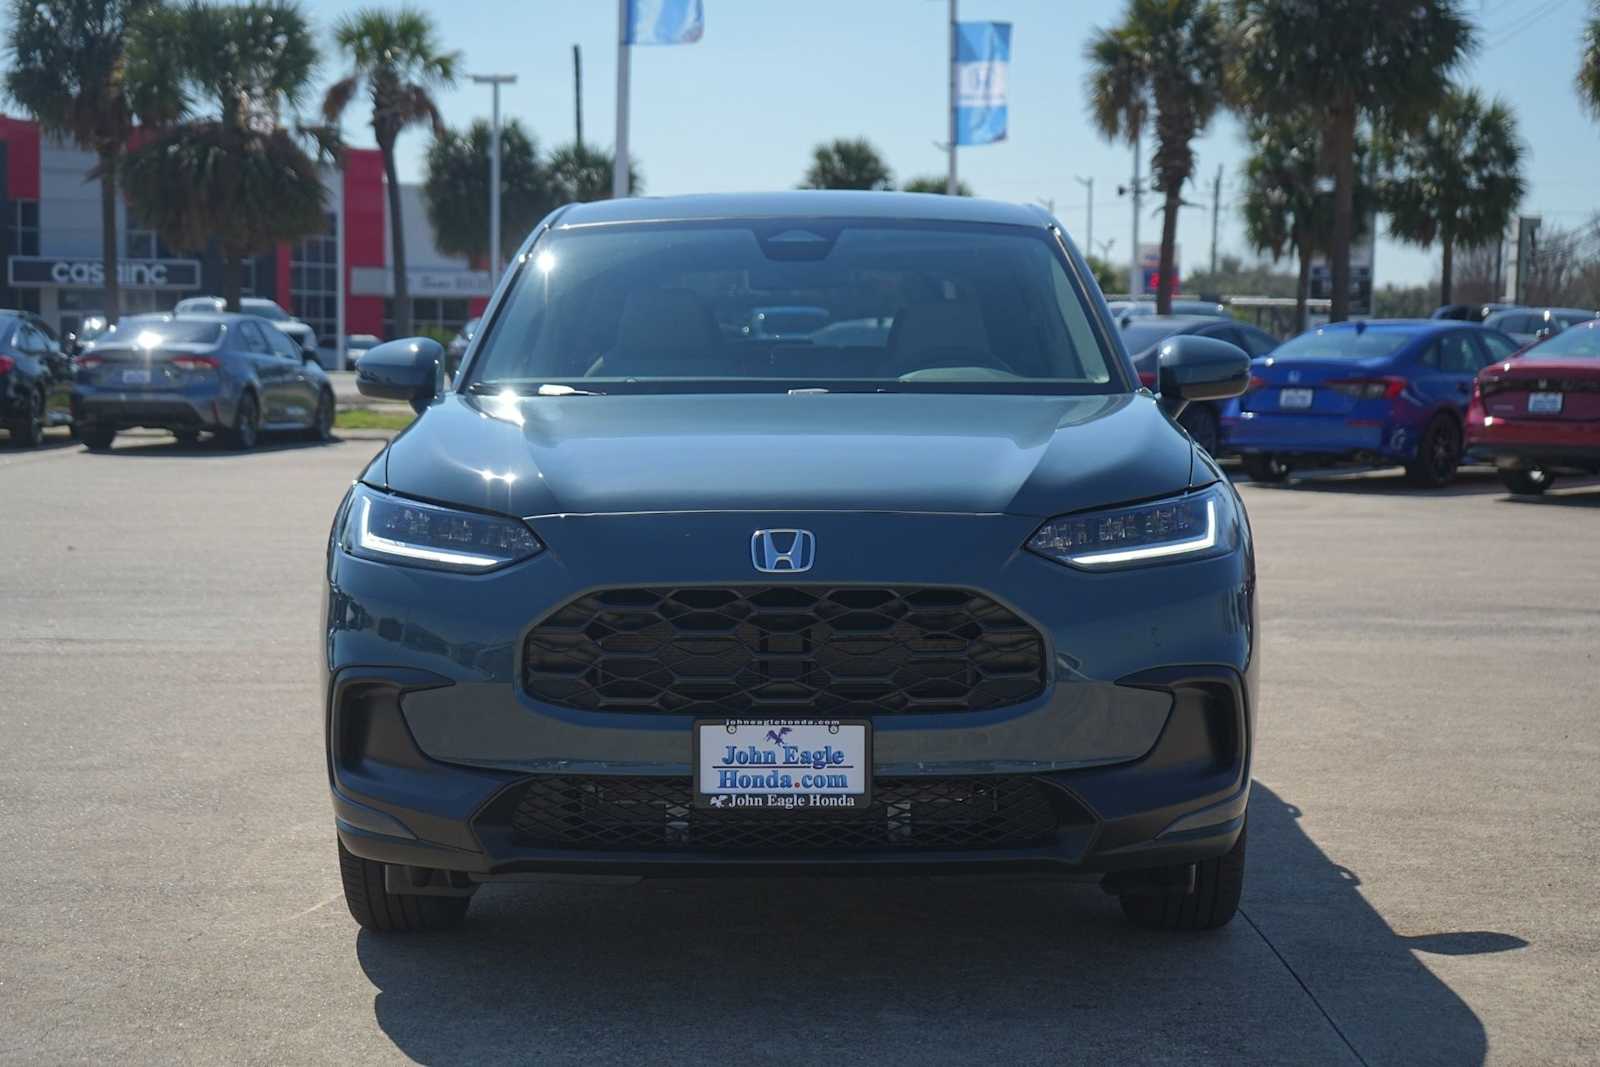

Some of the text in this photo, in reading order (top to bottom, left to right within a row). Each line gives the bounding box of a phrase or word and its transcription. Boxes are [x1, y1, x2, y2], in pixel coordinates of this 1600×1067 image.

[721, 745, 845, 769] John Eagle
[717, 769, 849, 788] Honda.com
[728, 794, 855, 809] John Eagle Honda
